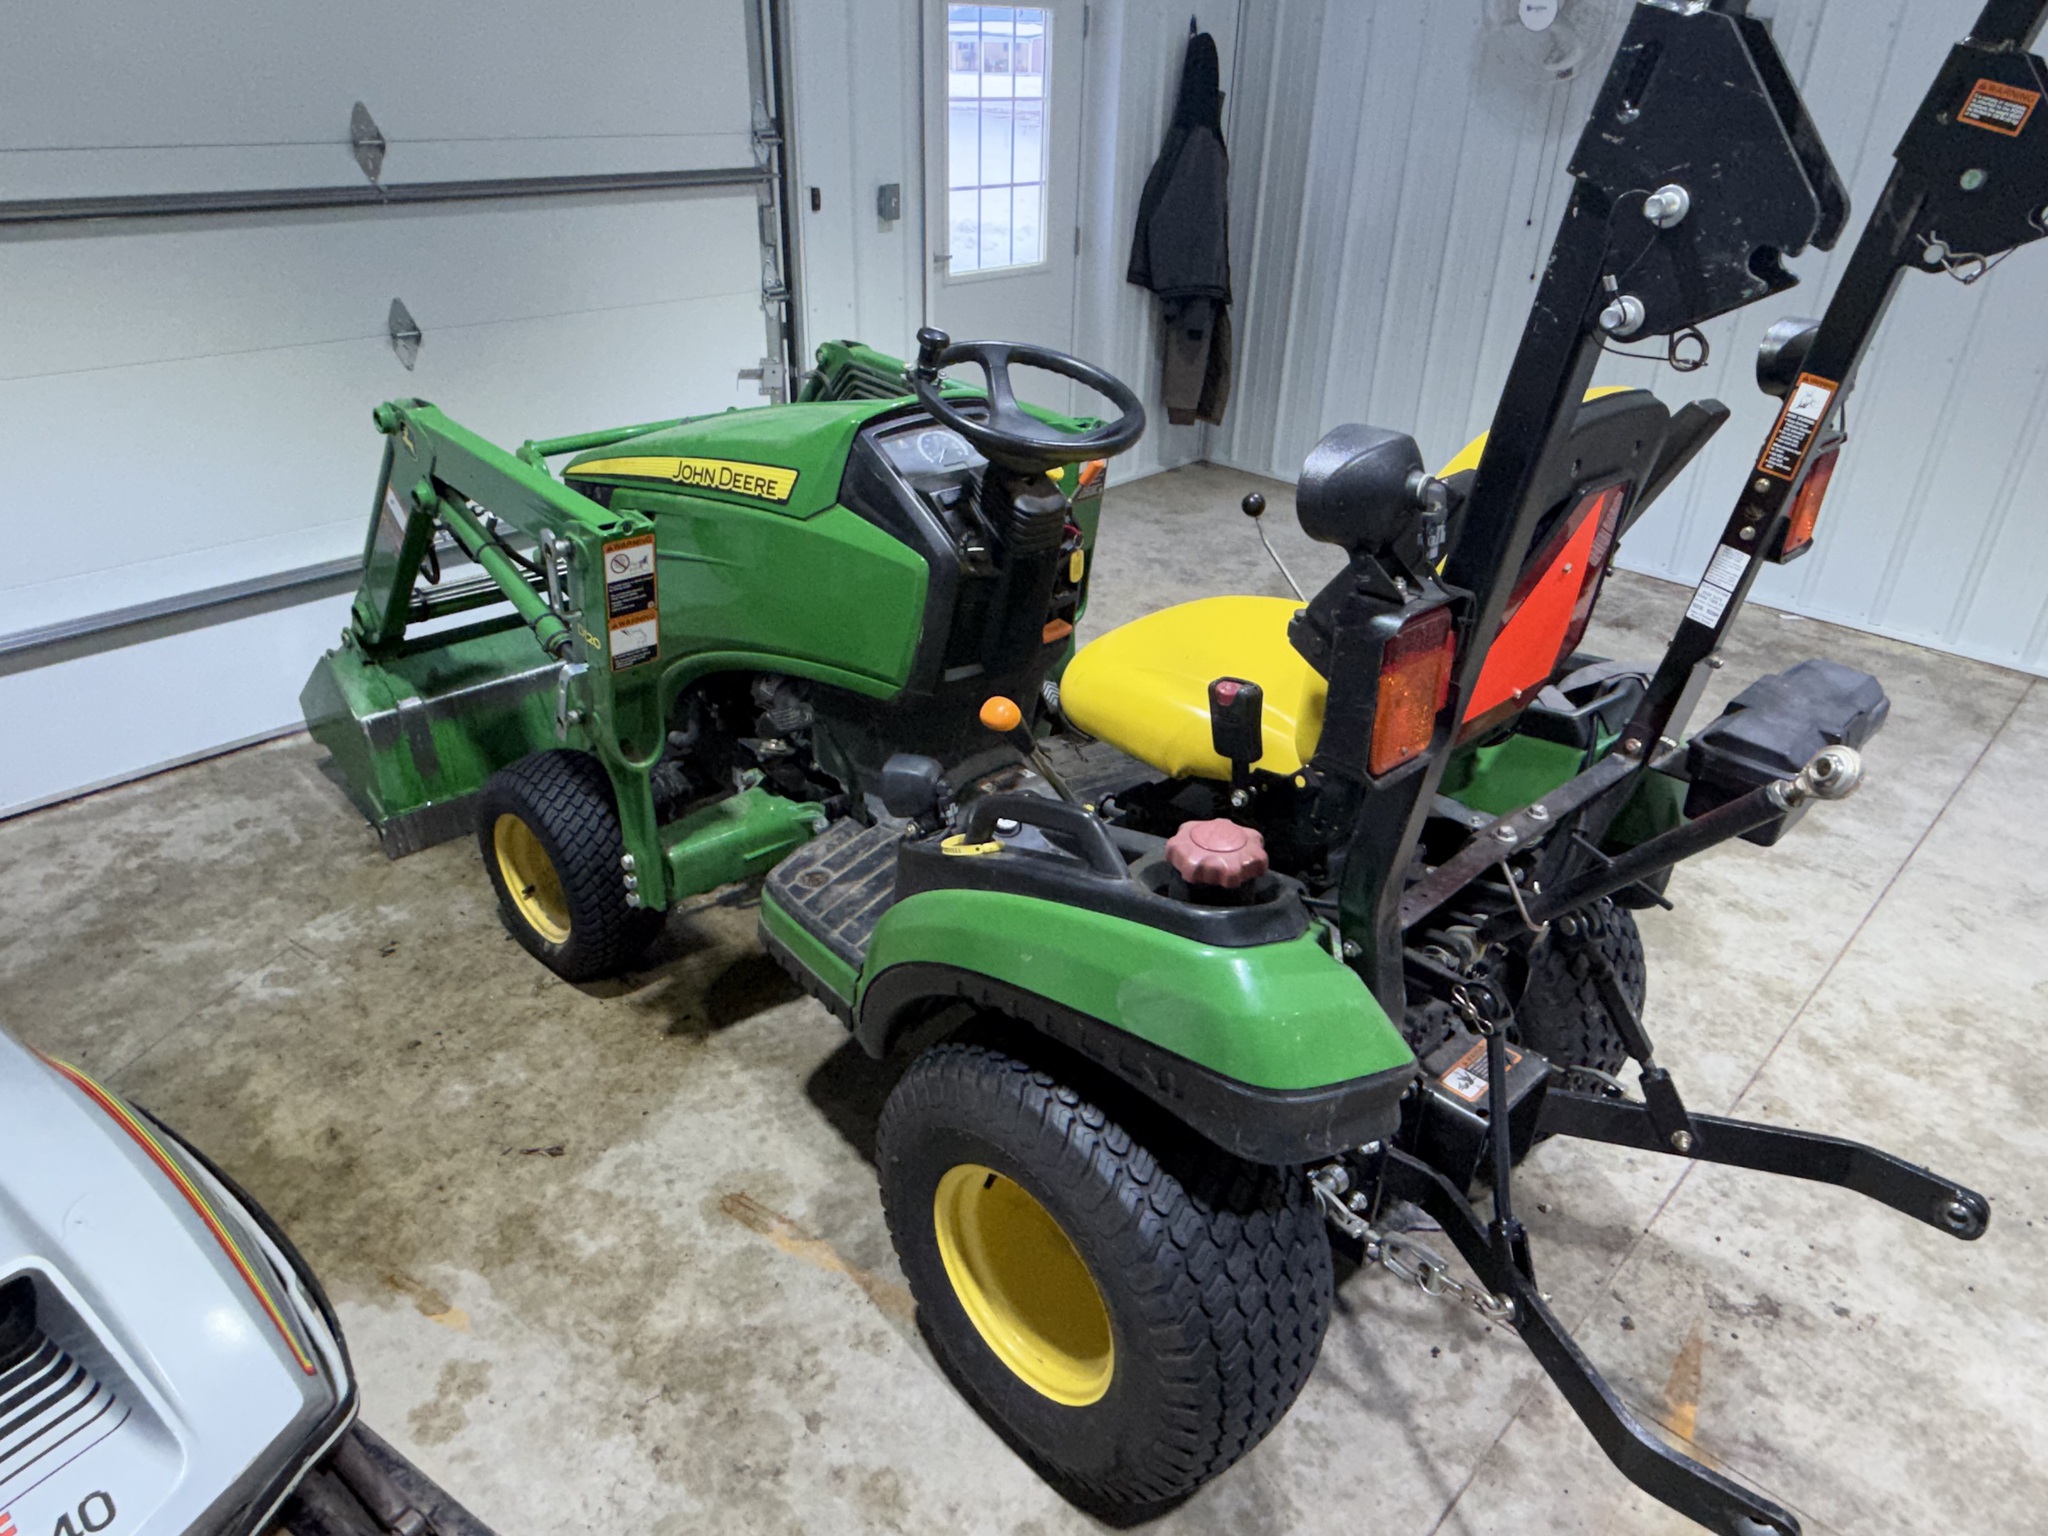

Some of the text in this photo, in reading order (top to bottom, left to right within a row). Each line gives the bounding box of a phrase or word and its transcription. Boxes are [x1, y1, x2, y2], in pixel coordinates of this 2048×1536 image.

[672, 460, 779, 497] JOHN DEERE
[613, 536, 653, 551] WARNING
[618, 613, 656, 629] WARNING
